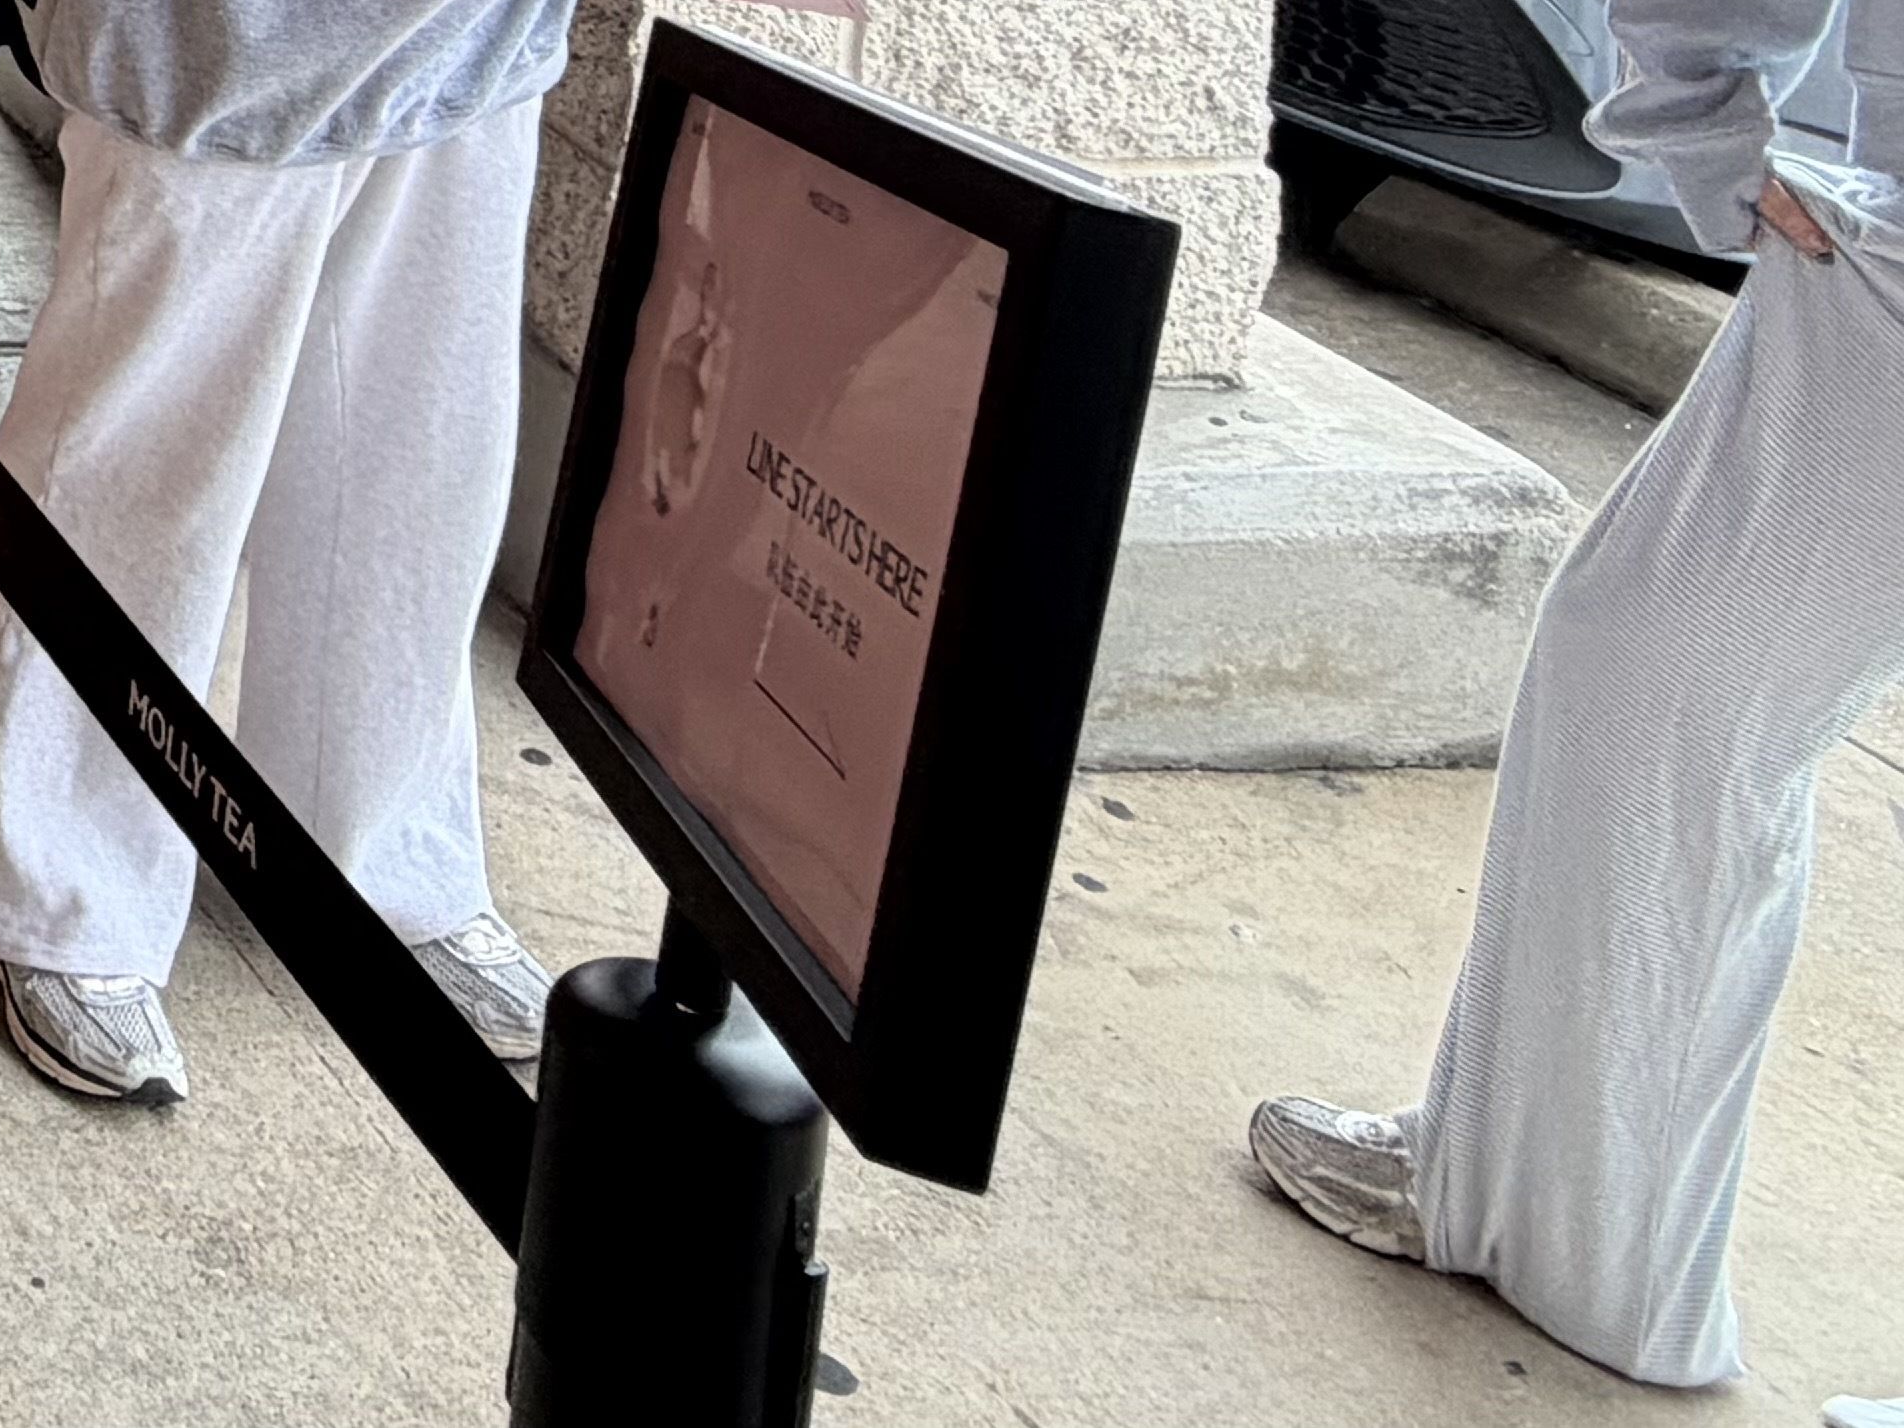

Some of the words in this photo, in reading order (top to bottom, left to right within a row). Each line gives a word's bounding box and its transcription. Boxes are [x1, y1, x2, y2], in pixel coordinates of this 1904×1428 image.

[746, 430, 791, 500] LINE
[786, 467, 867, 566] STARTS
[863, 530, 929, 618] HERE
[127, 678, 207, 799] MOLLY
[209, 775, 258, 871] TEA
